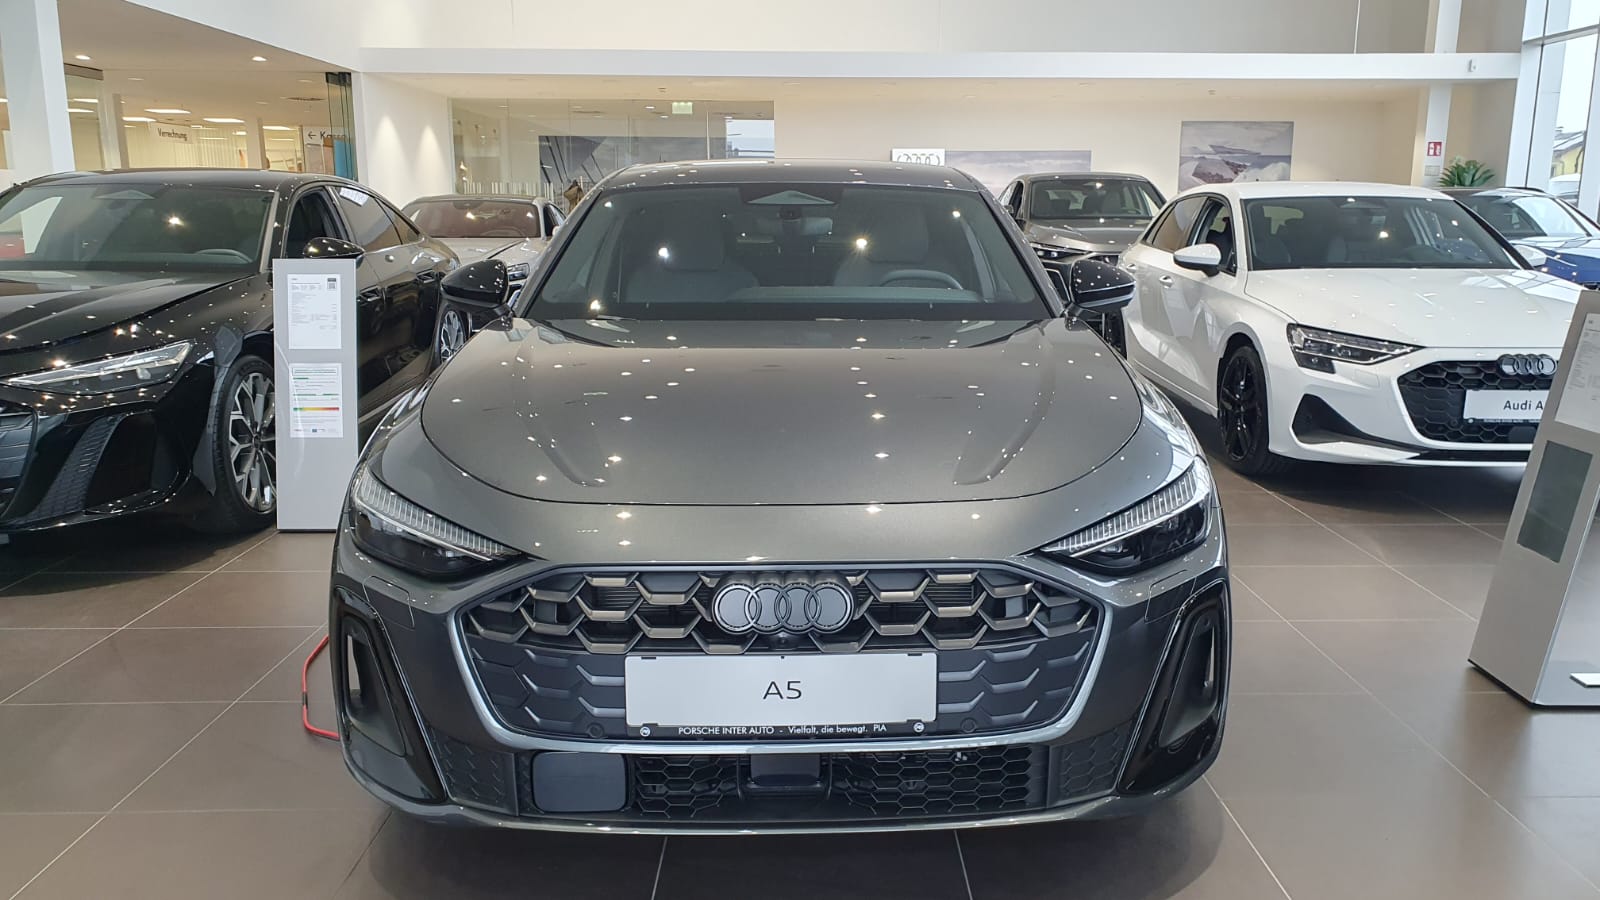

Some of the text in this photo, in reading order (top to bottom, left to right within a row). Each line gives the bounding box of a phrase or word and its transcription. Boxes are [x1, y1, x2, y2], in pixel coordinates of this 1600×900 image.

[1503, 399, 1544, 411] Audi A
[763, 680, 802, 700] A5
[678, 726, 721, 736] PORSCHE
[722, 726, 748, 735] INTER
[748, 725, 775, 735] AUTO
[788, 724, 819, 735] Vielfalt,
[821, 724, 834, 734] die
[836, 723, 868, 735] bewegt.
[873, 723, 887, 732] PIA
